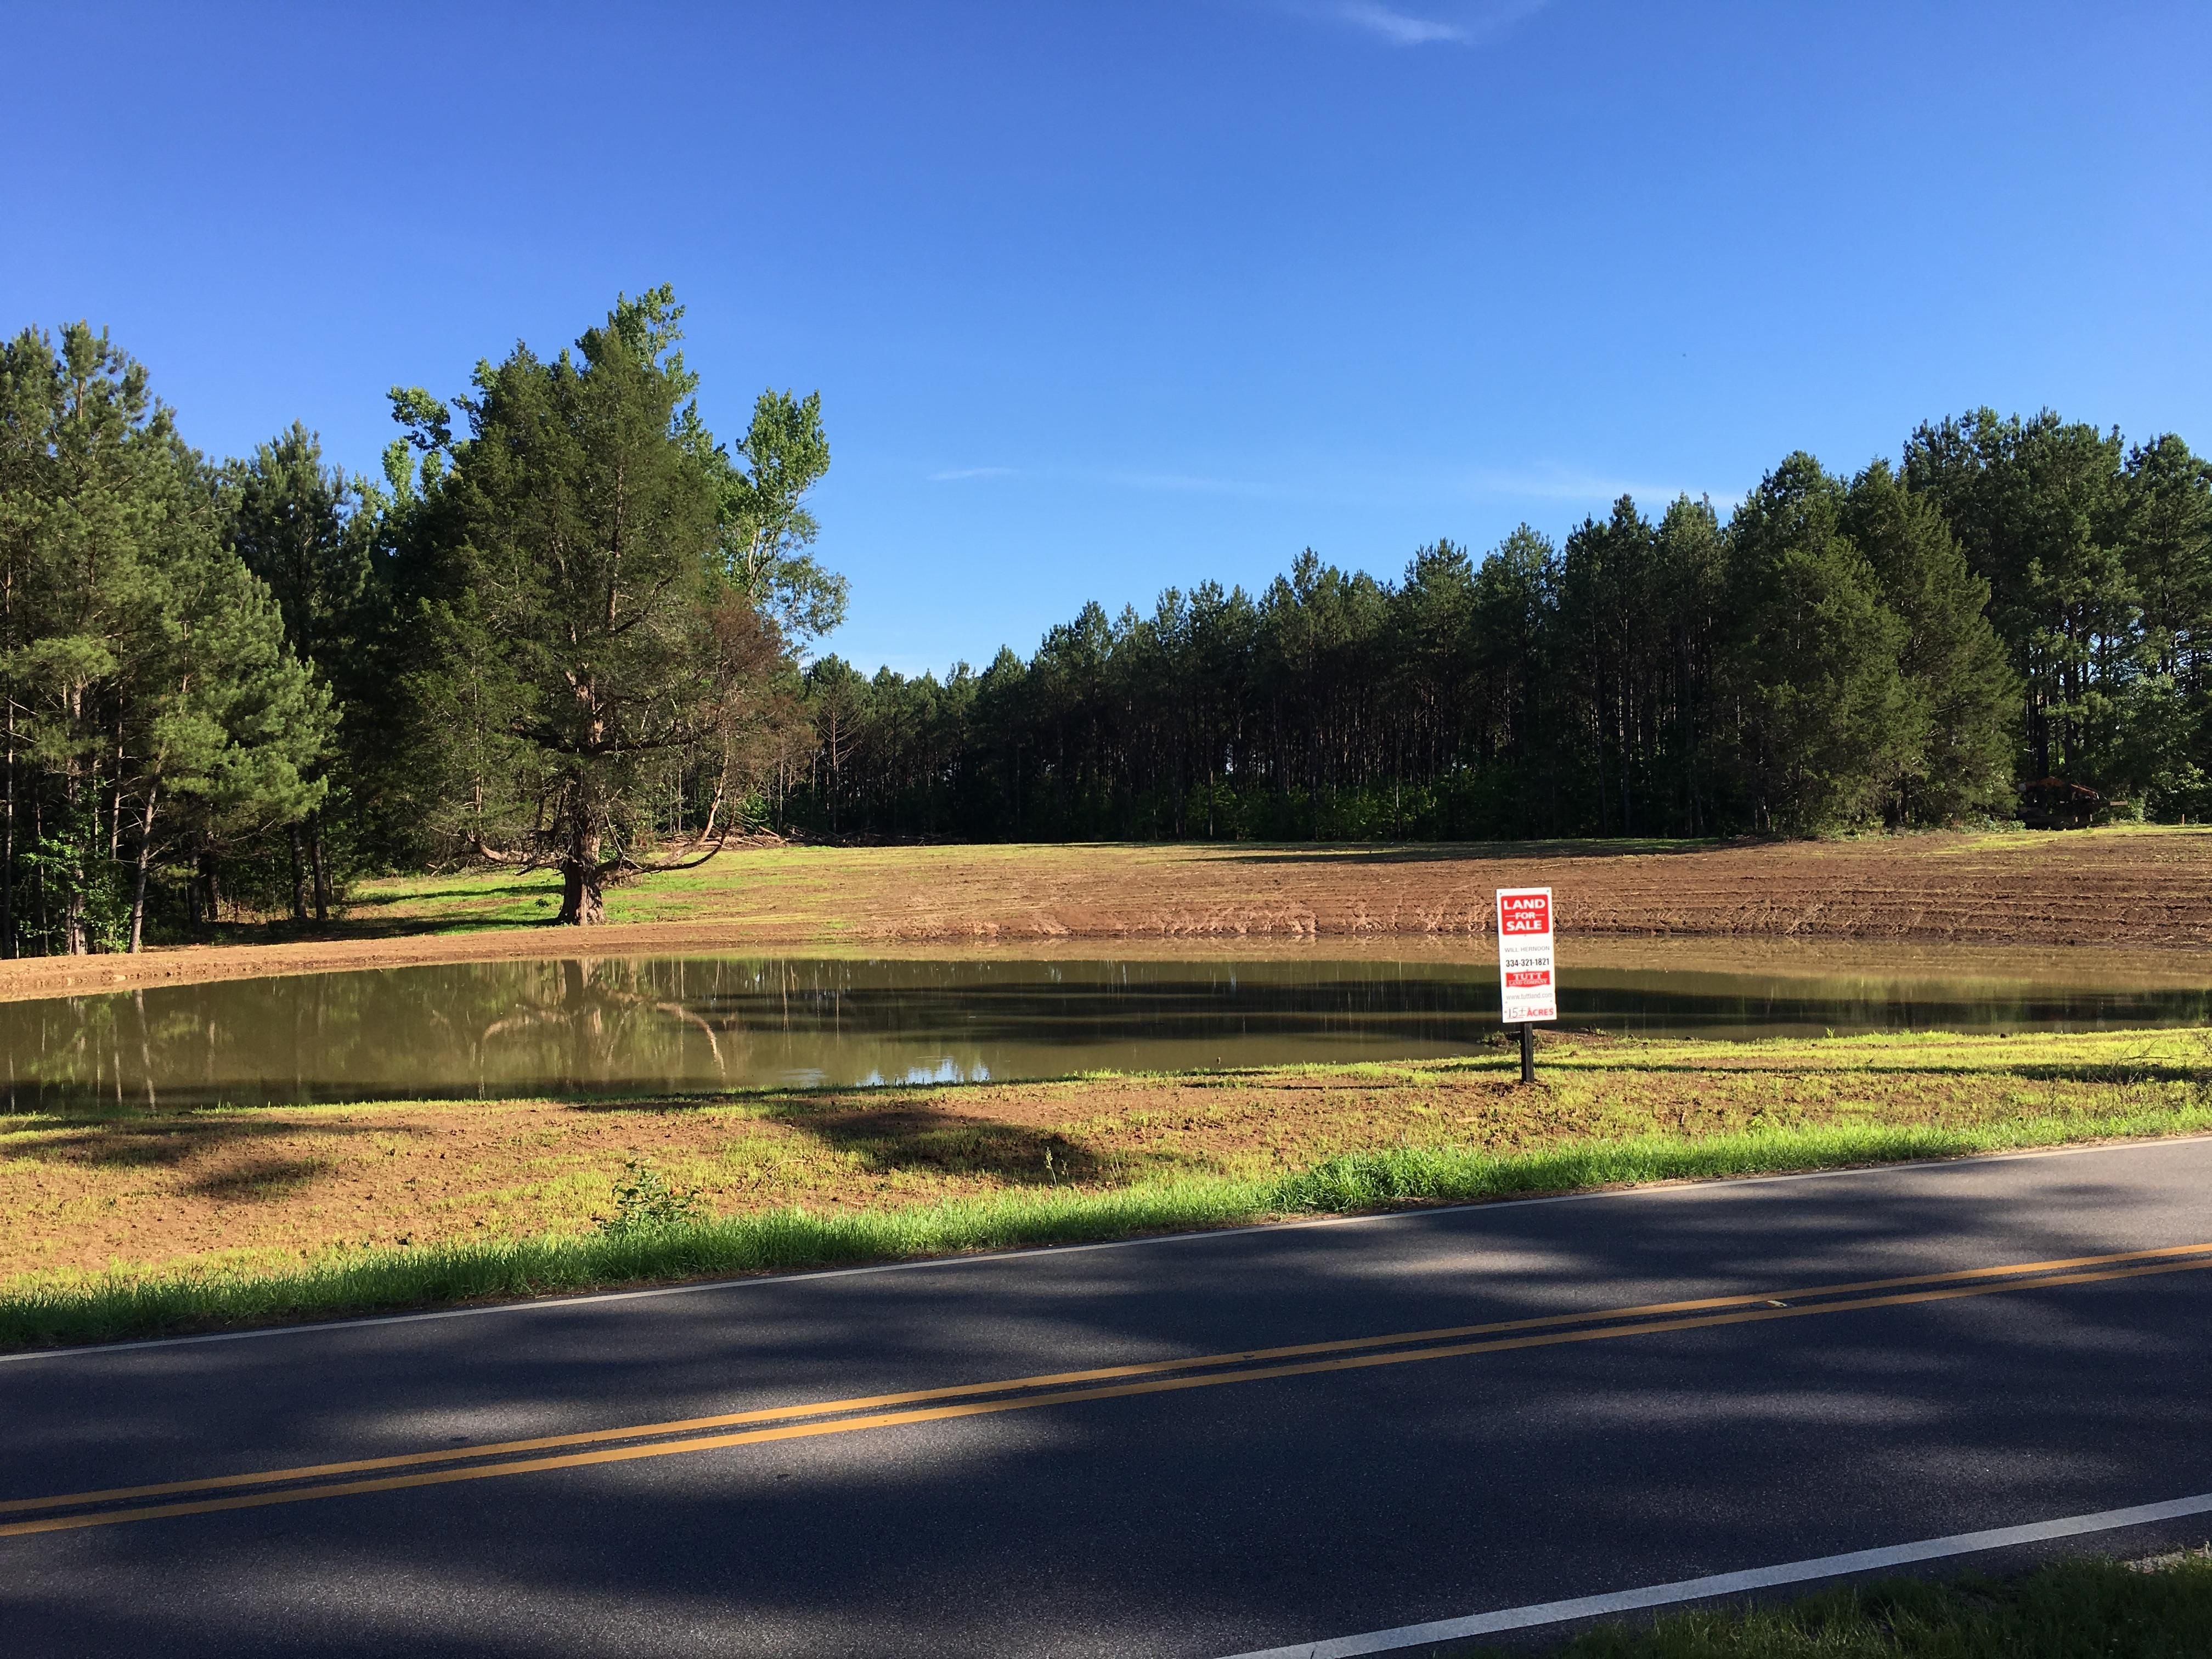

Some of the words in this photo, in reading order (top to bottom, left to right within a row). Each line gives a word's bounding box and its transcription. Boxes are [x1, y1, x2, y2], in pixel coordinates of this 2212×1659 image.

[1503, 899, 1545, 910] LAND
[1506, 920, 1542, 931] SALE
[1505, 958, 1549, 967] 334-321-1821
[1527, 1008, 1554, 1017] ACRES
